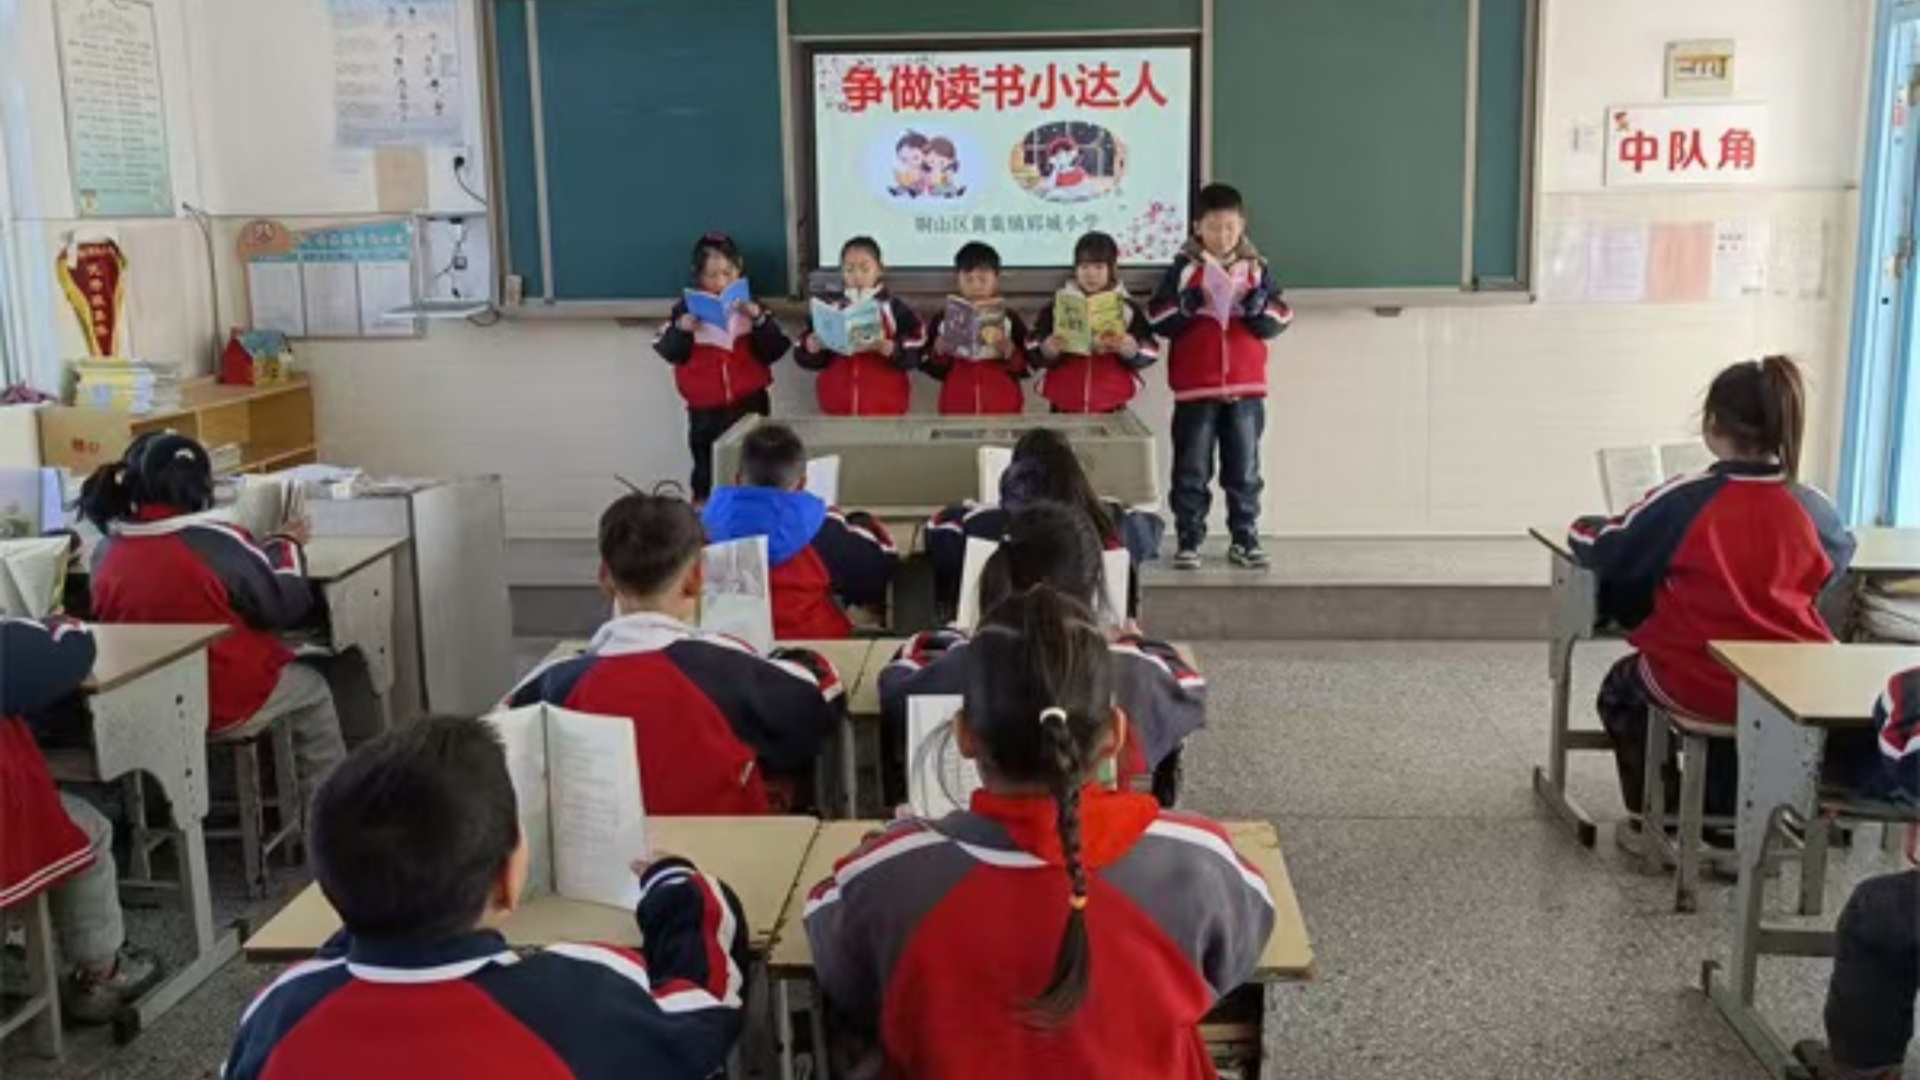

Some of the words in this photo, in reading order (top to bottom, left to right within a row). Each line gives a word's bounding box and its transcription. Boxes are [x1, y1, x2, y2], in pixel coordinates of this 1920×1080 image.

[842, 62, 1168, 112] 争做读书小达人
[1619, 129, 1755, 173] 中队角
